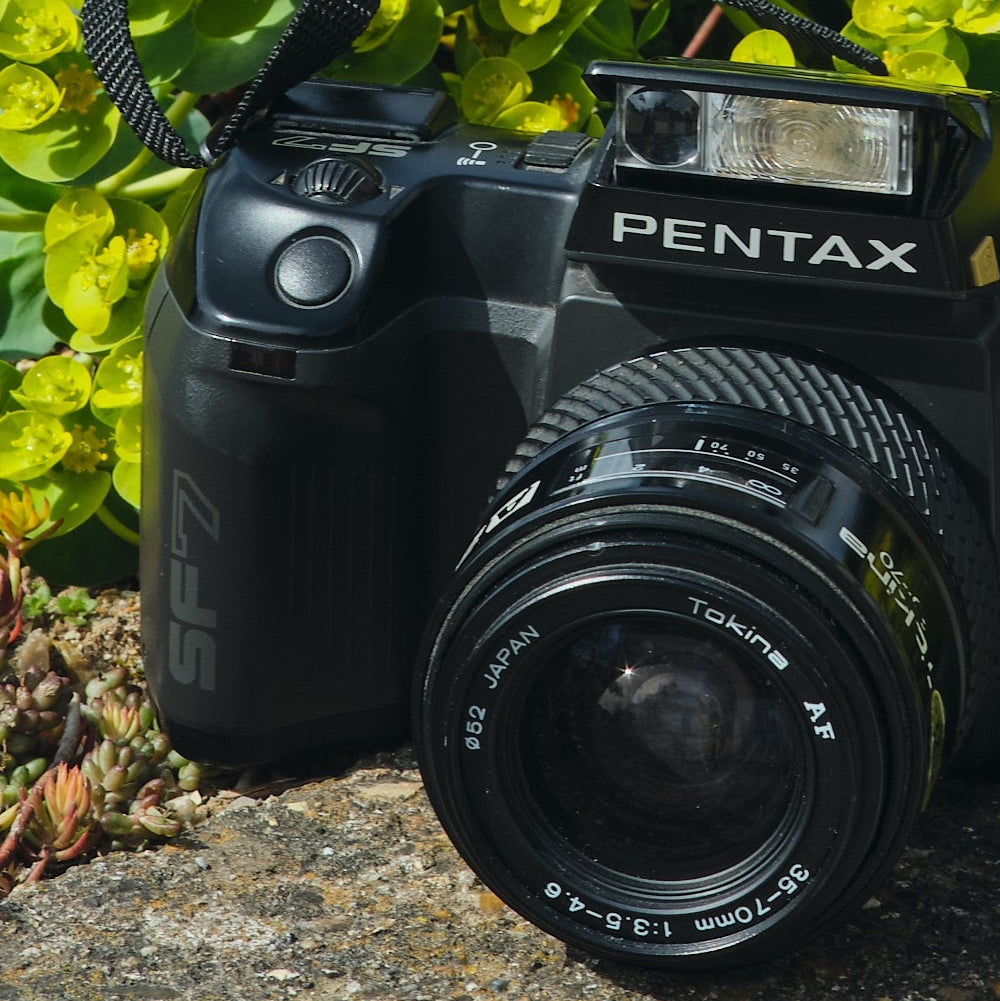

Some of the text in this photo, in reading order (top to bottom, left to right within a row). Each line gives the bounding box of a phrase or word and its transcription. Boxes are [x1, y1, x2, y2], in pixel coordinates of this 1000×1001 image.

[612, 211, 918, 274] PENTAX
[168, 467, 221, 692] SF7
[483, 624, 541, 690] JAPAN
[688, 596, 790, 671] Tokina
[803, 701, 836, 740] AF
[543, 881, 673, 938] 1:3.5-4.6
[694, 863, 810, 931] 35-70mm
